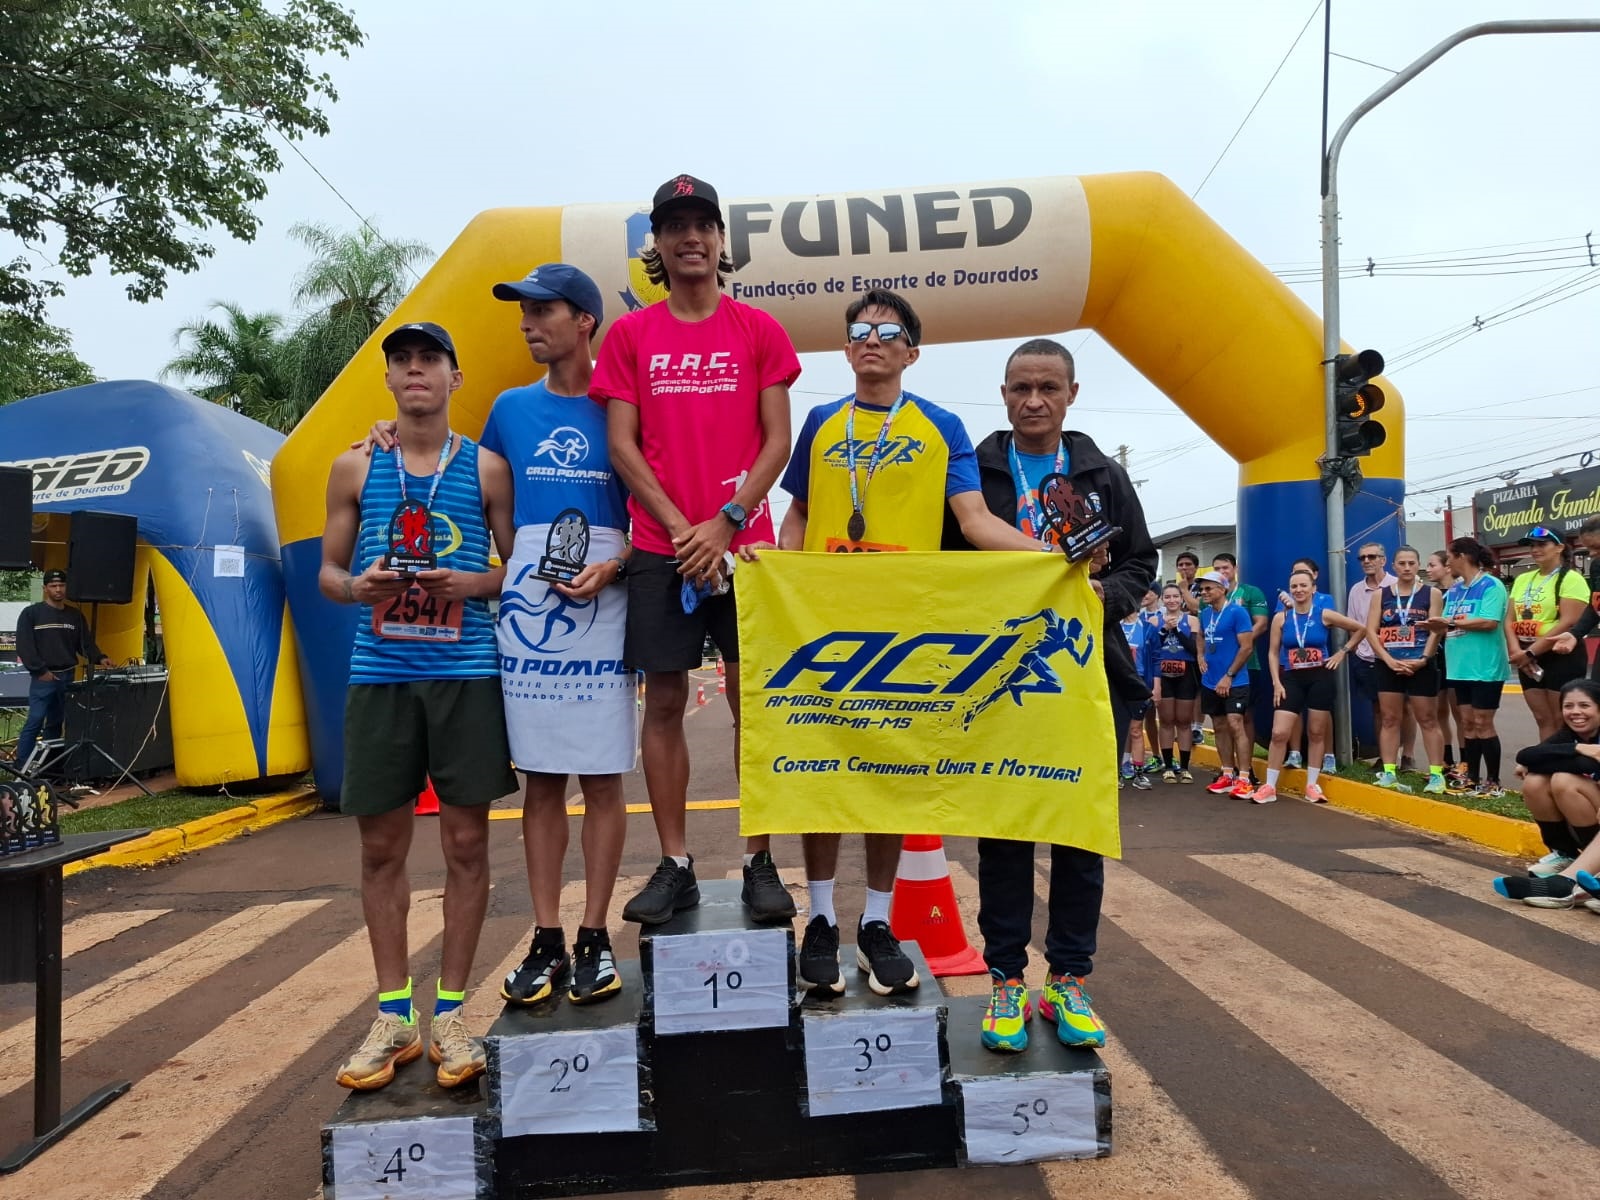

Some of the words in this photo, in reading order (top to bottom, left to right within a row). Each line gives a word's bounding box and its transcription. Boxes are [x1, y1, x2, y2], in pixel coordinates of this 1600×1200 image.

[729, 187, 1033, 272] FUNED
[732, 281, 818, 300] Fundação
[824, 277, 846, 294] de
[925, 271, 947, 288] de
[953, 265, 1039, 287] Dourados
[649, 351, 738, 372] A.A.C.
[556, 468, 612, 480] POMPEU
[55, 489, 70, 498] de
[72, 483, 126, 497] Dourados
[1492, 484, 1539, 505] PIZZARIA
[1483, 498, 1545, 537] Sagrada
[1549, 485, 1600, 520] Famíl
[763, 631, 1025, 694] ACI
[765, 694, 834, 709] AMIGOS
[838, 698, 956, 713] CORREDORES
[786, 712, 912, 730] IVINHEMA-MS
